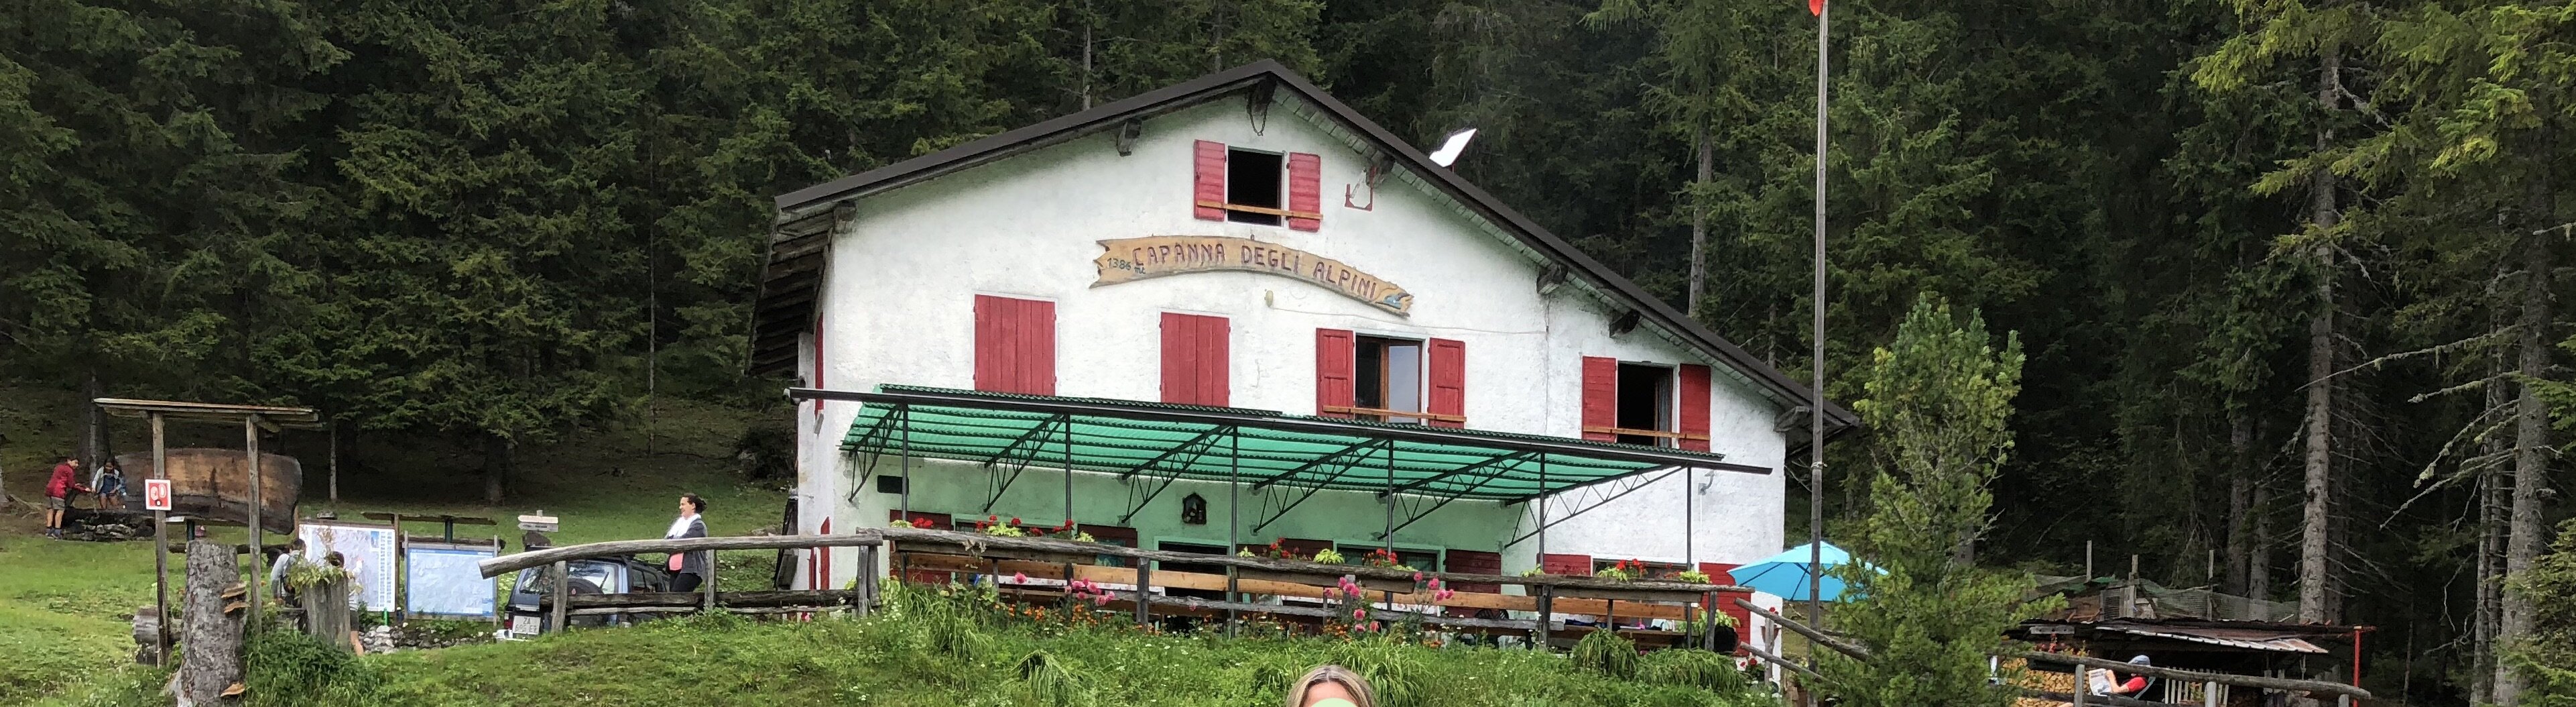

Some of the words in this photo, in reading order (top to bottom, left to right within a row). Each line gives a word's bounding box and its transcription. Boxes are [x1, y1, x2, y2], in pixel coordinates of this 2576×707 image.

[1107, 258, 1131, 270] 1386
[1132, 243, 1225, 267] CAPANNA
[1241, 245, 1299, 274] DEGLI
[1313, 262, 1377, 298] ALPINI
